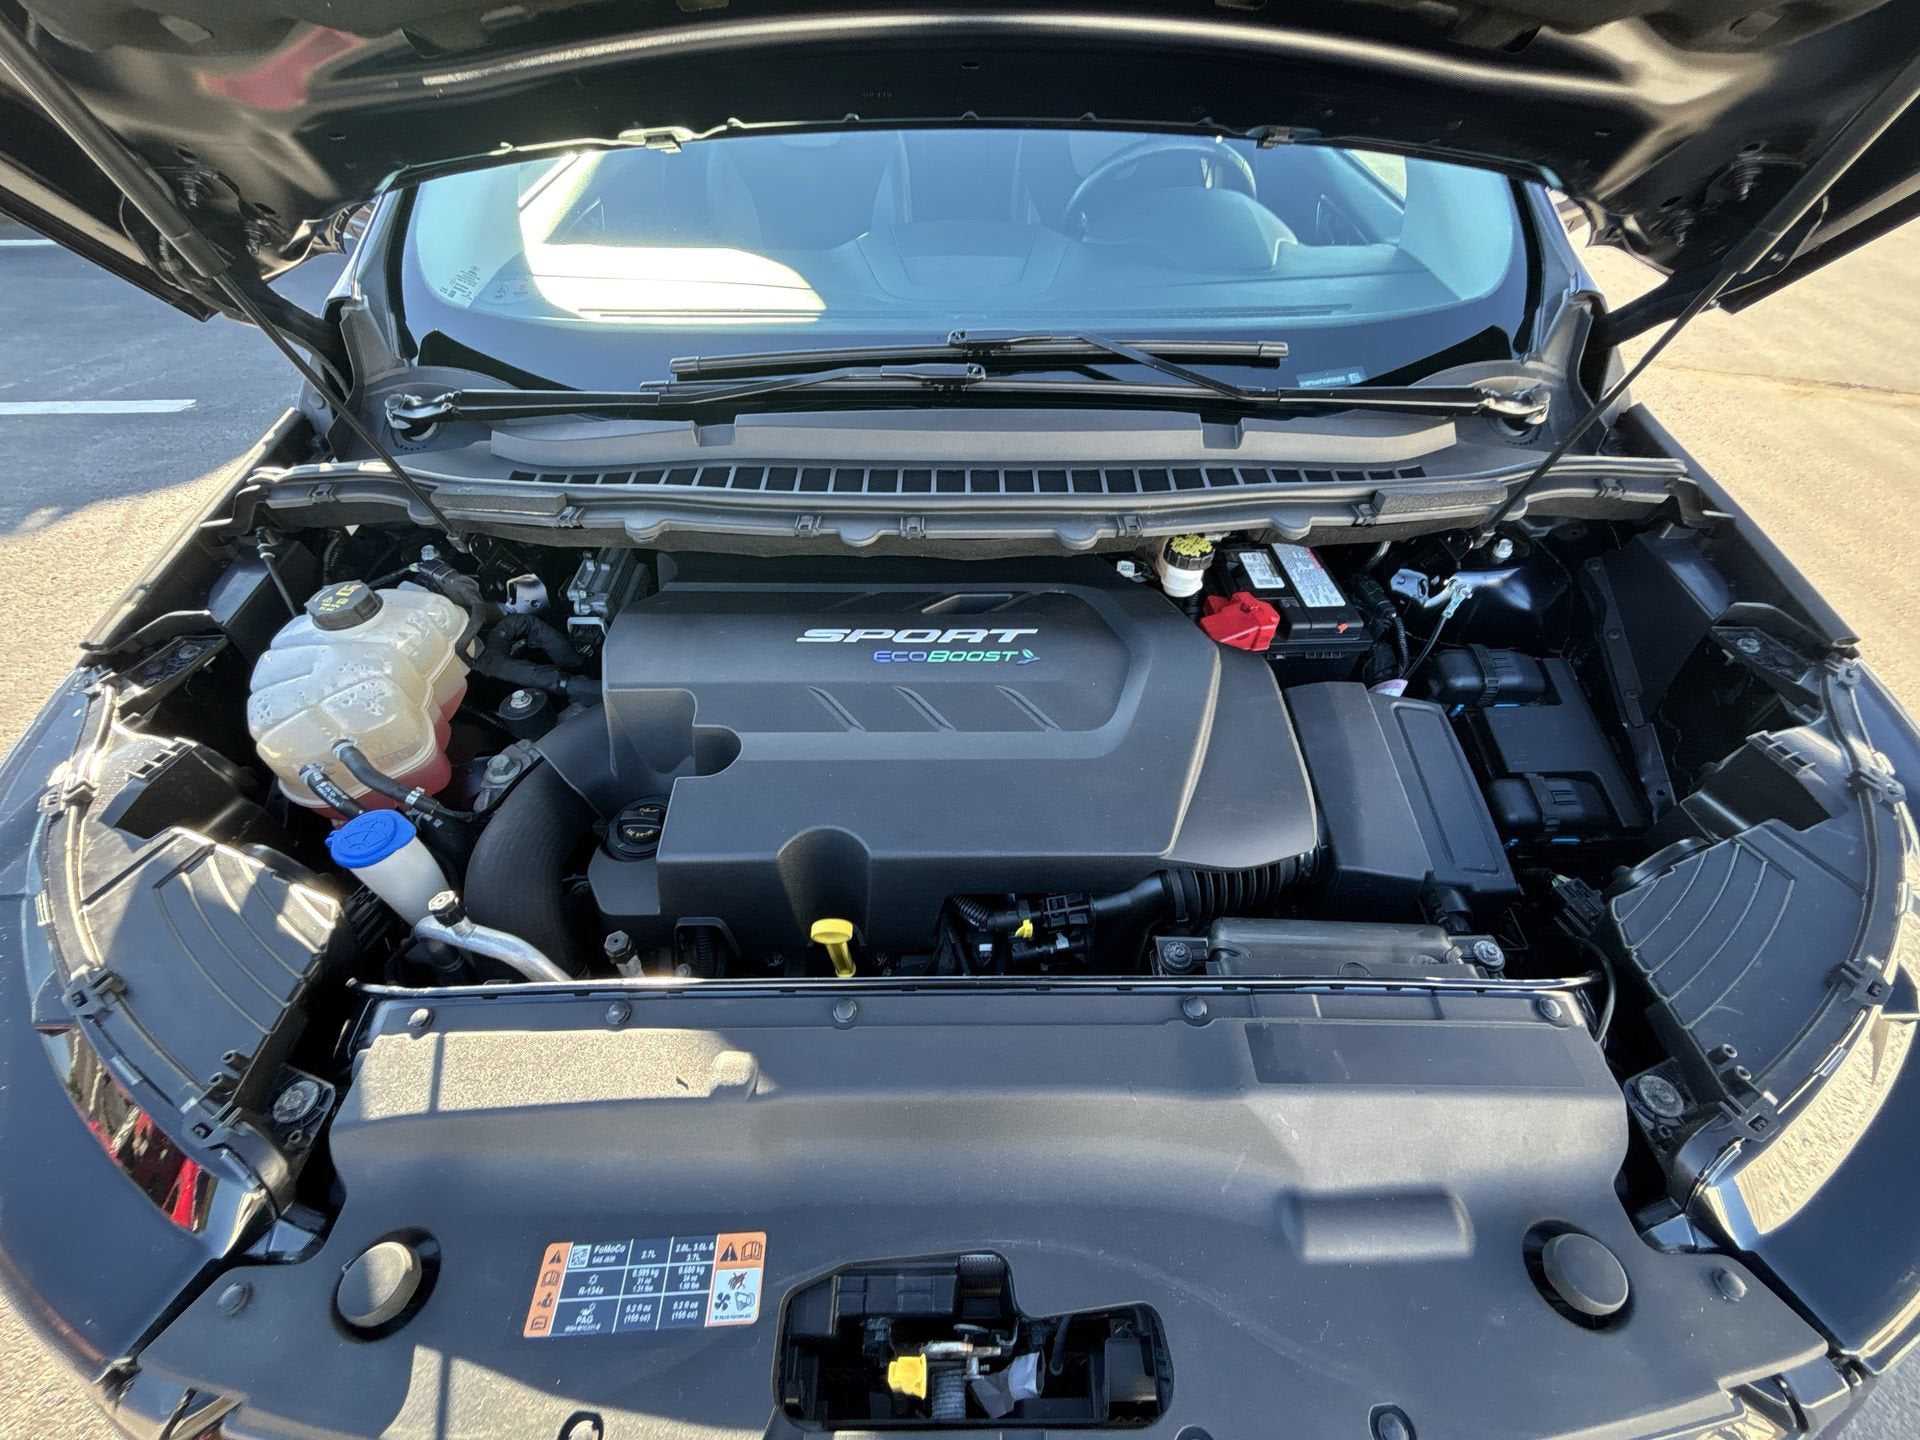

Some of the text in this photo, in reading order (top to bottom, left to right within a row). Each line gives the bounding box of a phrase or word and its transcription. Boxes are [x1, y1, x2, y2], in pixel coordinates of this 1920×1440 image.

[796, 628, 1038, 643] SPORT
[593, 1243, 626, 1254] FoMoCo
[641, 1249, 657, 1260] 2.7L
[650, 1268, 660, 1279] kg
[696, 1265, 705, 1276] kg
[577, 1286, 605, 1296] R-134a
[575, 1314, 594, 1325] PAG
